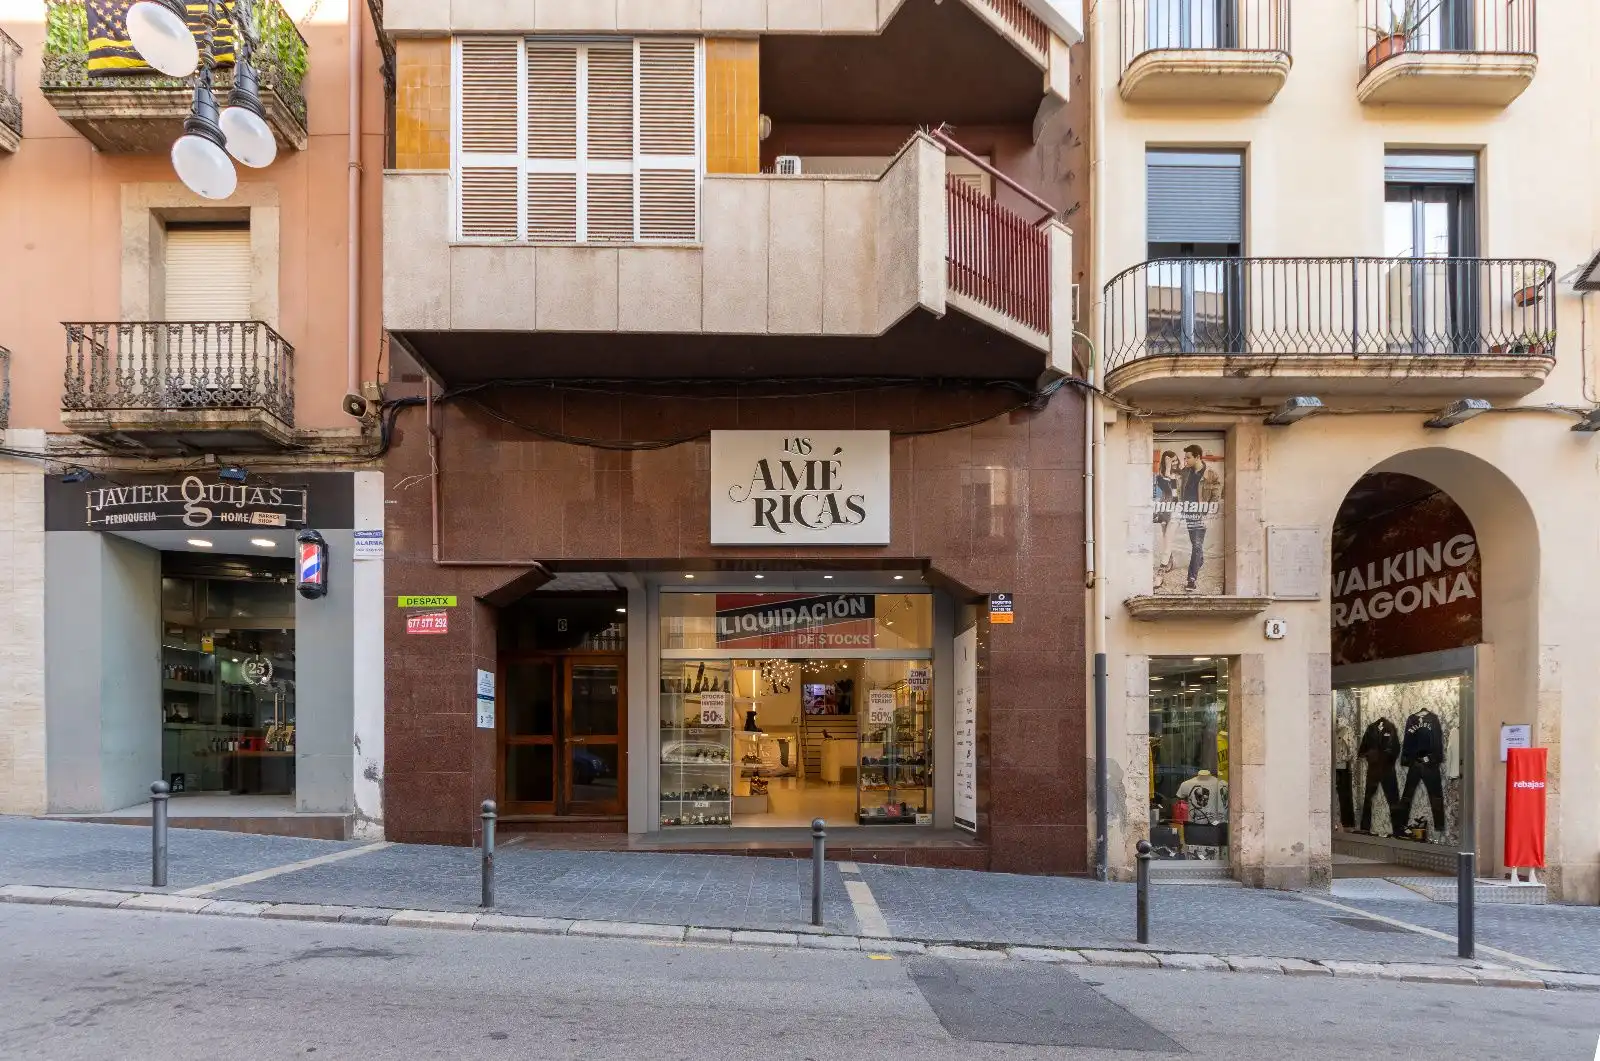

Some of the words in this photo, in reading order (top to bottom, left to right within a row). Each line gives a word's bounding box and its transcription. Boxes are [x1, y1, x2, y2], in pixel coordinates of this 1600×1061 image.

[783, 437, 812, 455] LAS
[728, 446, 843, 502] AMÉ
[96, 485, 169, 511] JAVIER
[752, 492, 866, 534] RICAS
[1153, 501, 1219, 514] mustang
[105, 512, 156, 524] PERRUQUERIA
[407, 597, 448, 605] DESPATX
[721, 595, 866, 635] LIQUIDACIÓN
[1272, 624, 1280, 636] 8
[798, 634, 814, 645] DE
[818, 634, 870, 645] STOCKS
[248, 662, 265, 675] 25
[910, 670, 926, 678] ZONA
[703, 710, 723, 723] 50%
[871, 711, 892, 722] 50%
[1513, 780, 1545, 789] rebajas
